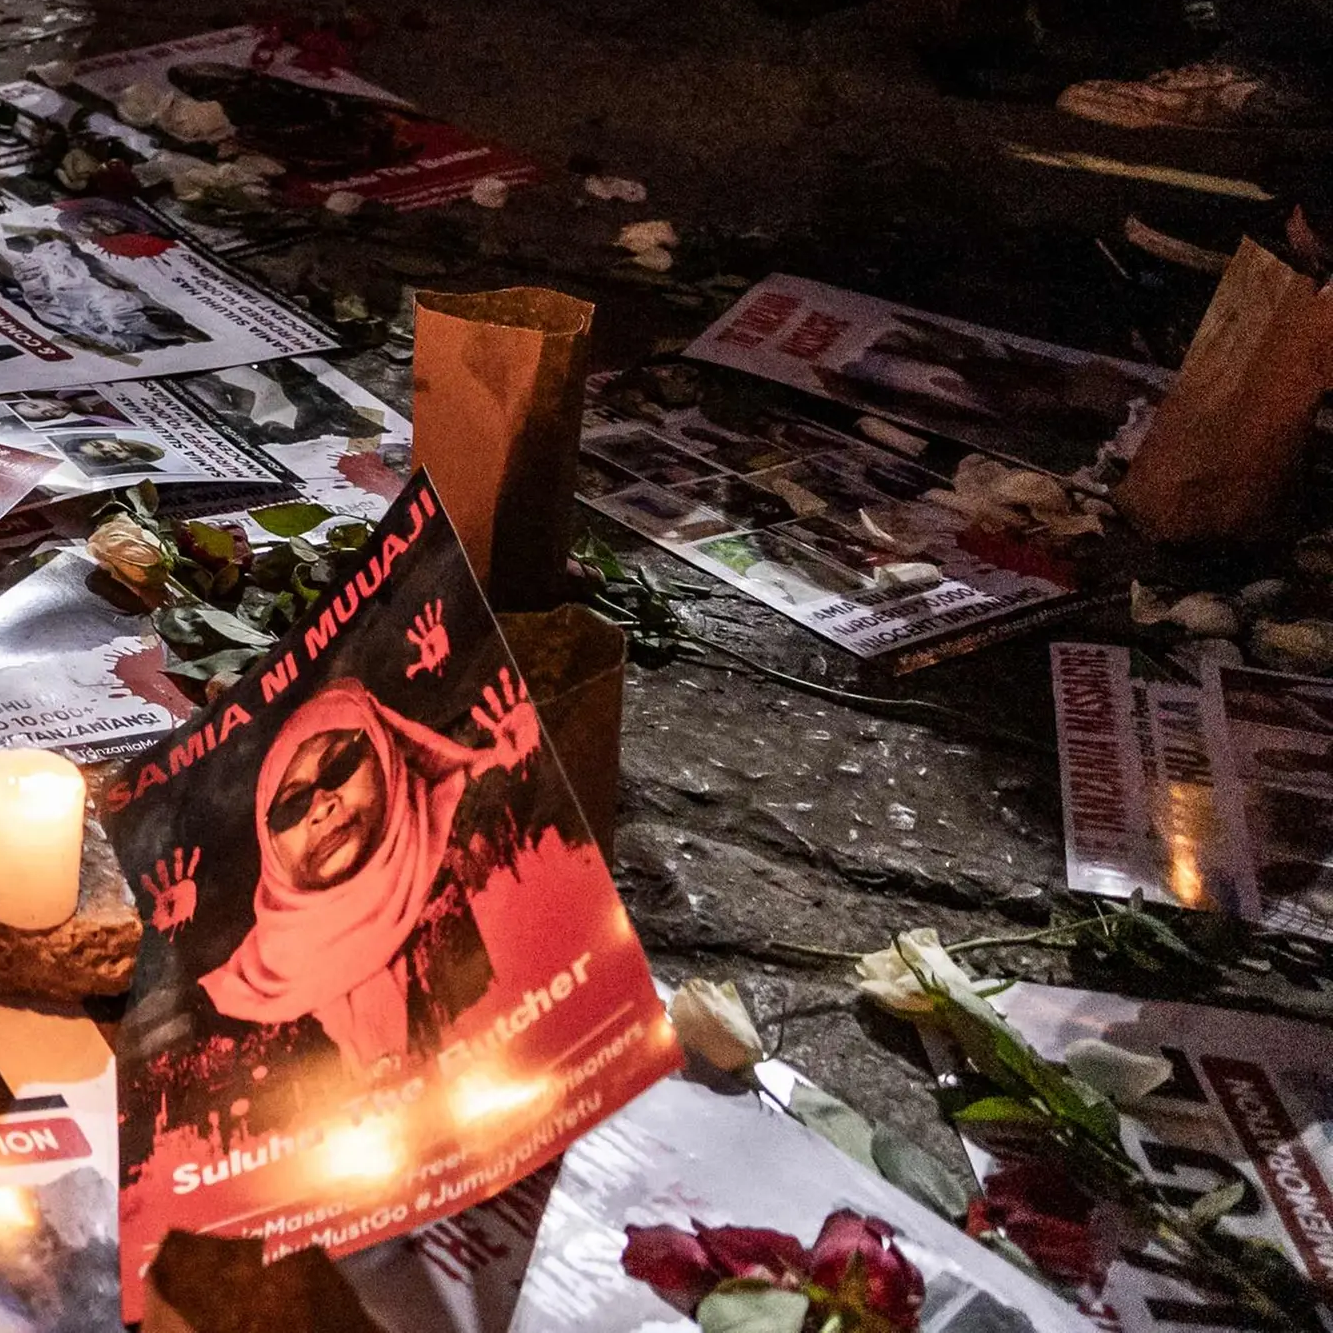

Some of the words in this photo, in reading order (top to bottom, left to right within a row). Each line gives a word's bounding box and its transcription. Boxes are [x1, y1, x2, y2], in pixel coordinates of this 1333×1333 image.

[196, 295, 251, 327] SULUHU
[238, 305, 313, 351] MURDERED
[259, 303, 329, 349] INNOCENT
[203, 437, 272, 480] INNOCENT
[104, 700, 252, 813] SAMIA
[259, 655, 301, 703] NI
[304, 485, 437, 662] MUUAJI
[437, 950, 593, 1076] Butcher
[414, 1091, 604, 1214] #JumuiyaNiYetu
